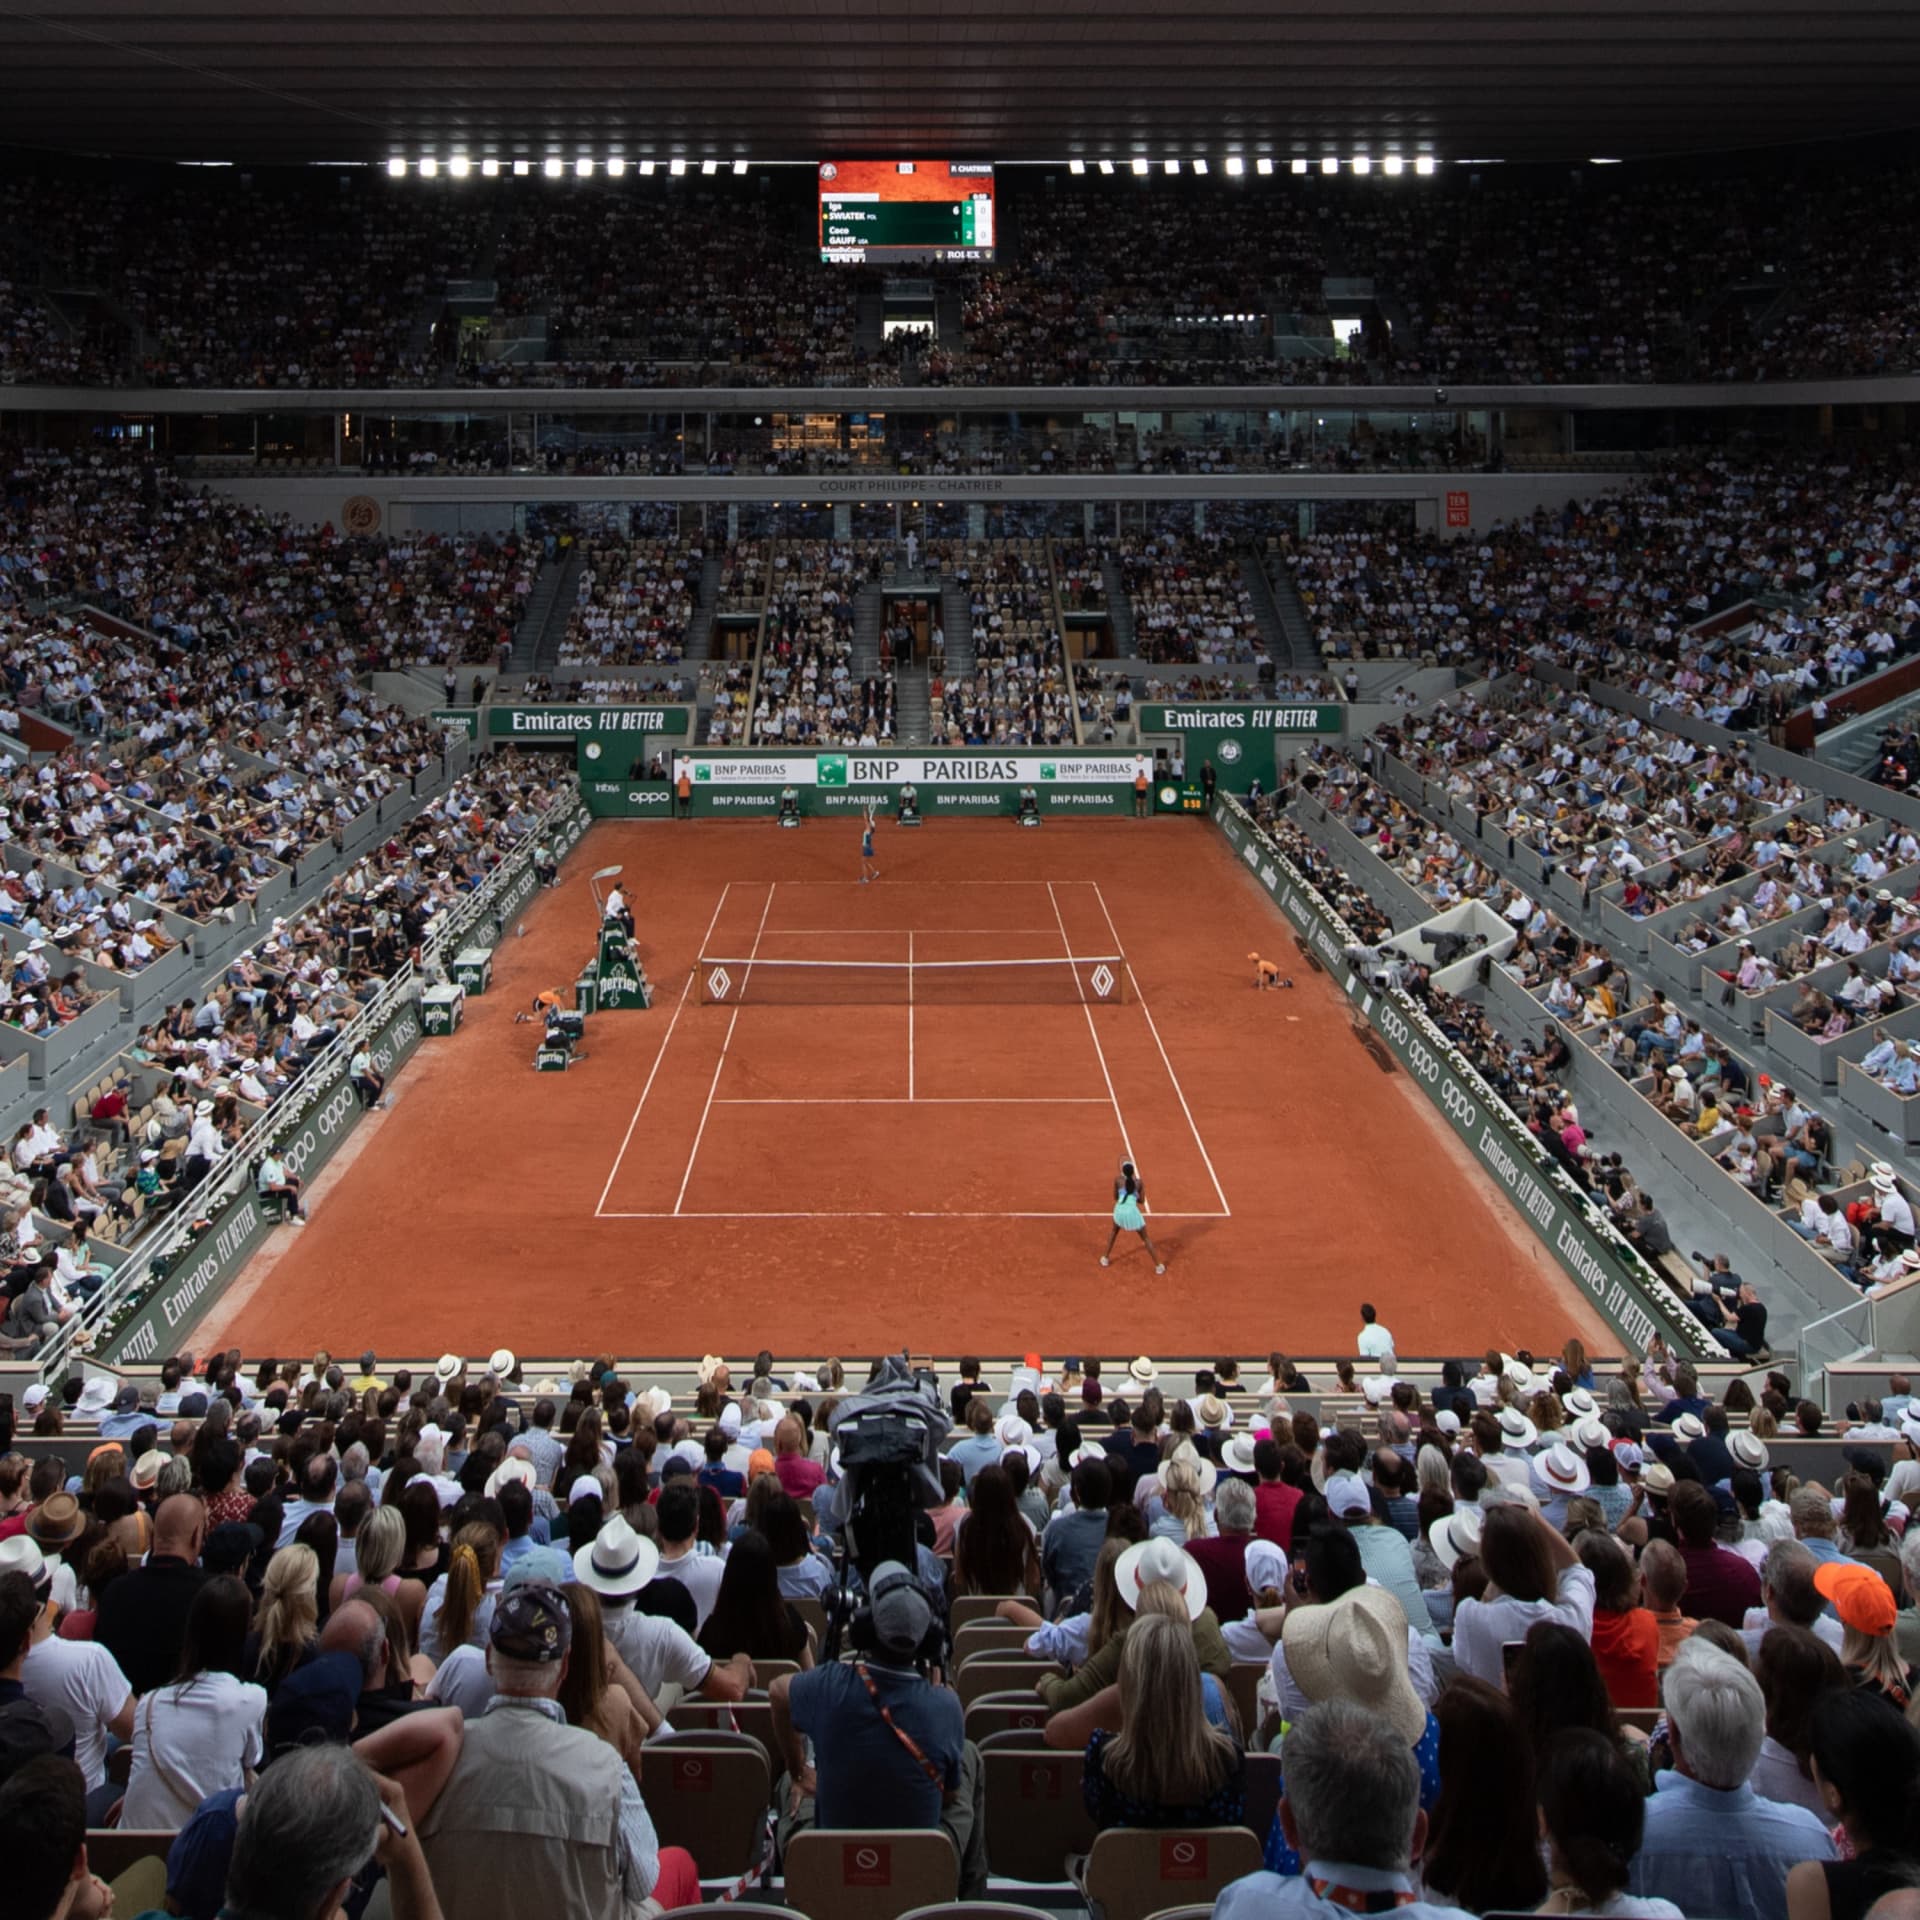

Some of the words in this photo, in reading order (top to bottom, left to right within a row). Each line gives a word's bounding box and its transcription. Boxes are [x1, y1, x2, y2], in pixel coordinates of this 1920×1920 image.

[829, 202, 842, 212] Iga
[952, 206, 960, 215] 6
[966, 206, 973, 215] 2
[829, 226, 849, 235] Coco
[966, 230, 973, 239] 2
[829, 236, 856, 245] GAUFF
[947, 251, 980, 259] ROLEX
[819, 480, 863, 492] COURT
[868, 480, 926, 492] PHILIPPE
[938, 480, 1003, 491] CHATRIER
[512, 711, 593, 731] Emirates
[599, 711, 619, 730] FLY
[621, 711, 664, 730] BETTER
[1164, 709, 1245, 728] Emirates
[1252, 709, 1272, 728] FLY
[1275, 709, 1318, 728] BETTER
[714, 764, 738, 775] BNP
[740, 764, 786, 775] PARIBAS
[853, 760, 899, 780] BNP
[923, 760, 1018, 780] PARIBAS
[1059, 763, 1083, 774] BNP
[1085, 763, 1132, 774] PARIBAS
[629, 792, 669, 804] oppo
[712, 796, 733, 805] BNP
[734, 796, 776, 805] PARIBAS
[825, 795, 846, 805] BNP
[847, 795, 889, 805] PARIBAS
[937, 795, 958, 805] BNP
[959, 795, 1000, 805] PARIBAS
[1050, 794, 1071, 804] BNP
[1073, 794, 1114, 804] PARIBAS
[1317, 929, 1342, 965] RENAULT
[1380, 1005, 1408, 1045] oppo
[1409, 1039, 1439, 1083] oppo
[1442, 1078, 1476, 1127] oppo
[318, 1086, 353, 1135] oppo
[284, 1130, 316, 1174] ppo
[1479, 1125, 1519, 1187] Emirates
[1516, 1171, 1534, 1202] FLY
[1526, 1184, 1556, 1231] BETTER
[162, 1253, 218, 1328] Emirates
[216, 1229, 233, 1265] FLY
[228, 1202, 257, 1250] BETTER
[1557, 1220, 1608, 1297] Emirates
[1604, 1280, 1627, 1316] FLY
[1618, 1297, 1657, 1354] BETTER
